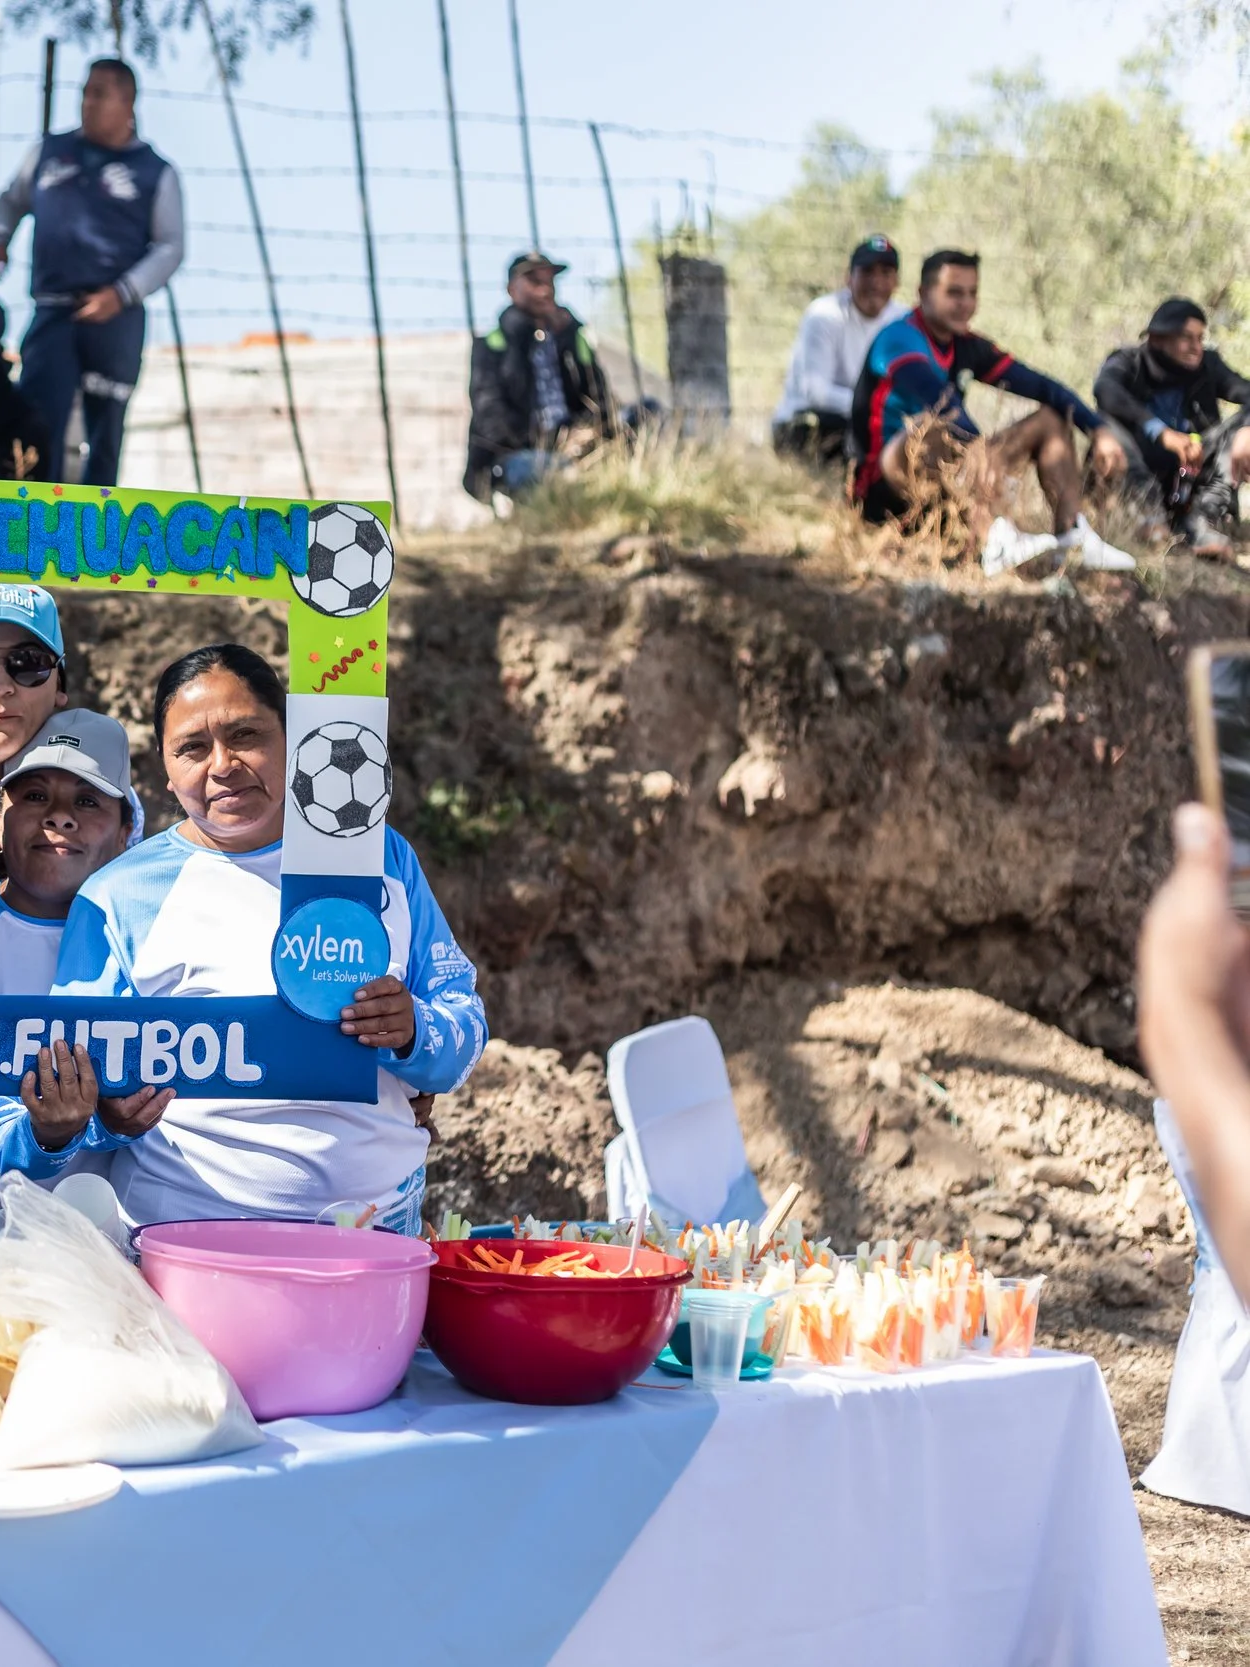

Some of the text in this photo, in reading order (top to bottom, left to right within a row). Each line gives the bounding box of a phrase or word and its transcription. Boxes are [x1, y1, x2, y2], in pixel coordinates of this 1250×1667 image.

[280, 924, 364, 971] xylem
[312, 968, 381, 983] Let's Solve Wat
